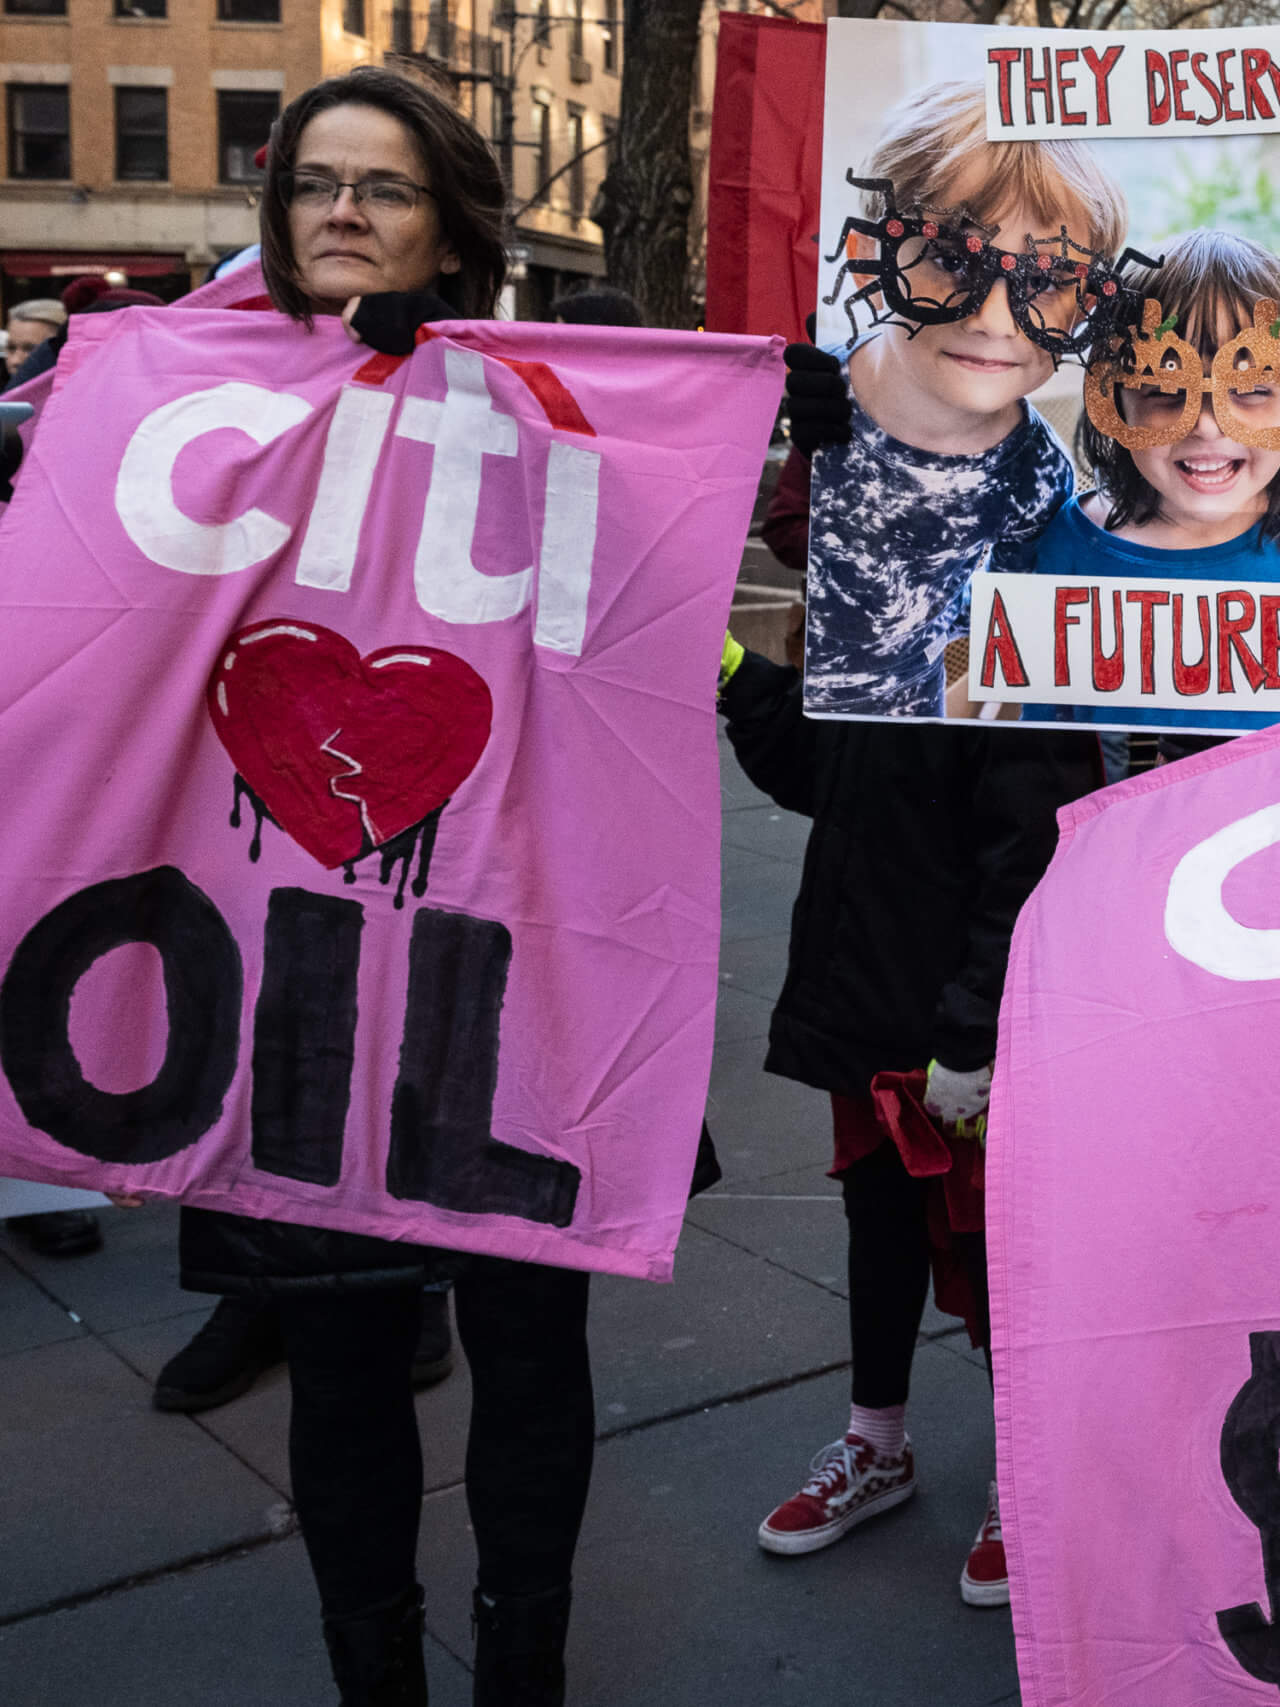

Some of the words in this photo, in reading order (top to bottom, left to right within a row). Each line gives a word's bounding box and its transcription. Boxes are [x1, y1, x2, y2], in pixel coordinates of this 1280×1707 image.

[987, 45, 1125, 127] THEY
[115, 348, 600, 656] citi
[979, 587, 1028, 689] A
[0, 864, 582, 1227] OIL
